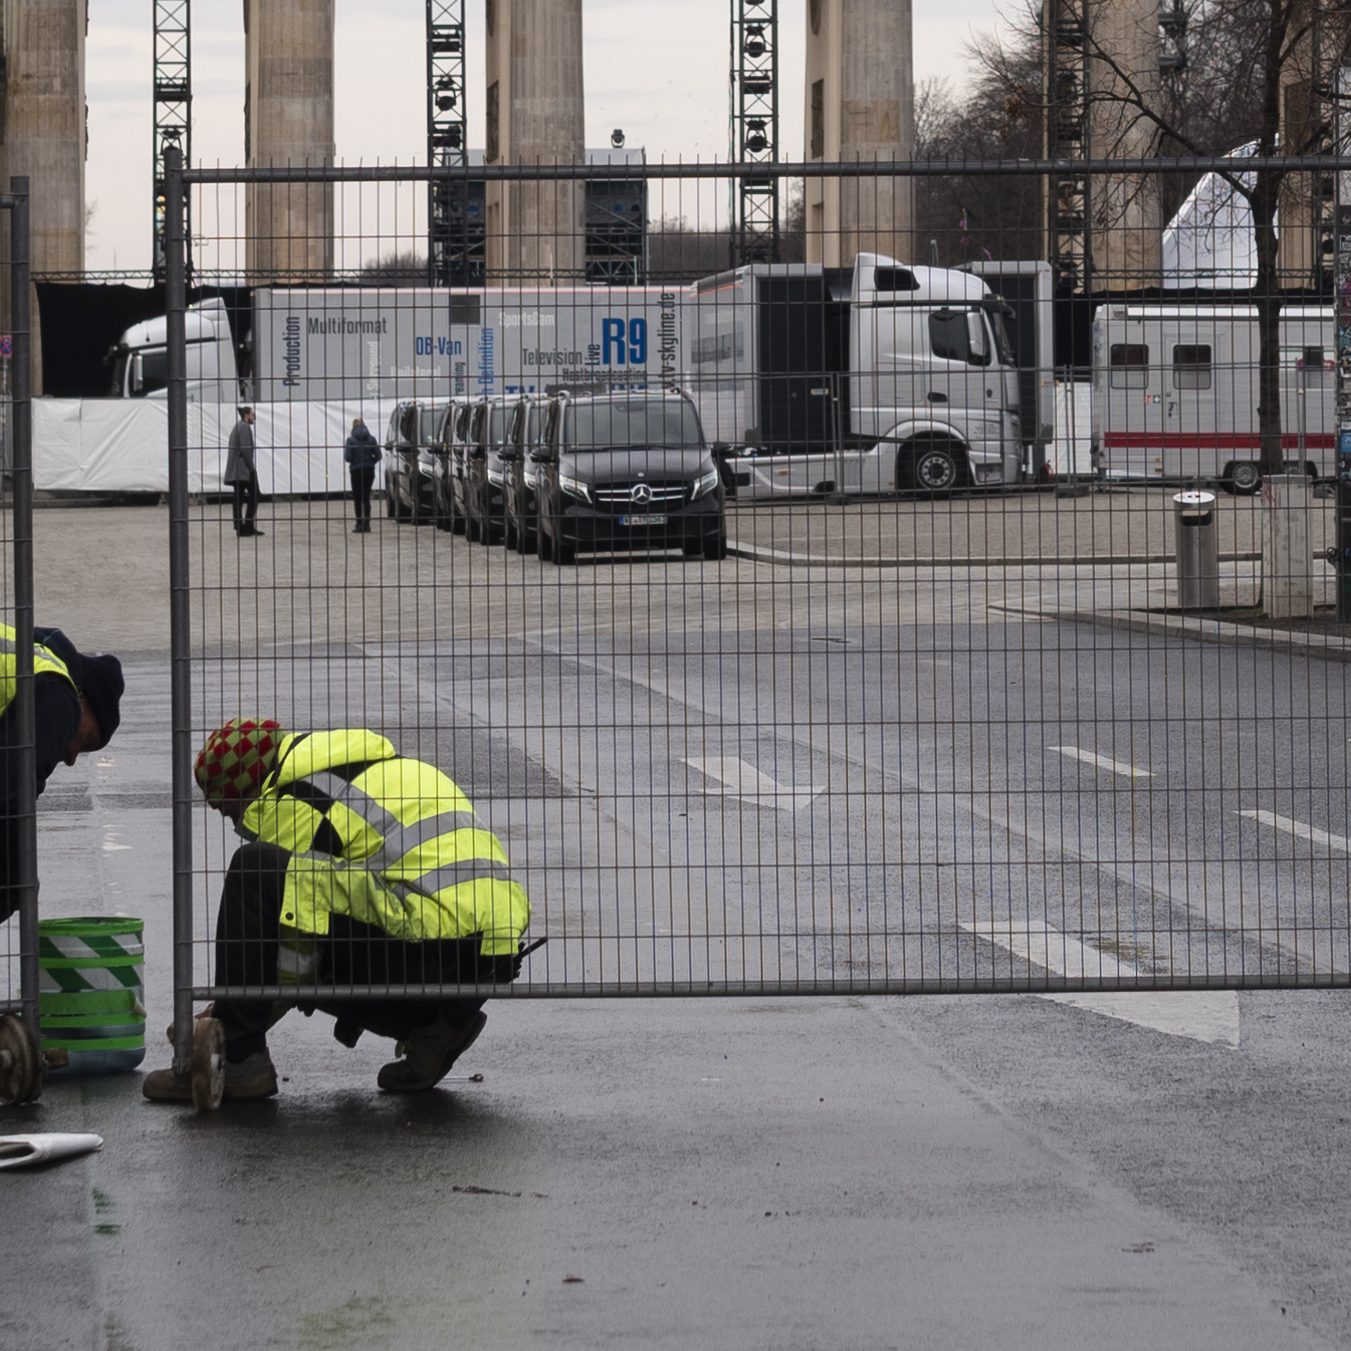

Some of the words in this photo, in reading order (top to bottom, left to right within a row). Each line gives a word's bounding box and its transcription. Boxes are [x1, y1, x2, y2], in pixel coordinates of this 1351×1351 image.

[308, 317, 388, 335] Multiformat
[499, 311, 555, 328] SportsCam
[282, 316, 300, 387] Production
[415, 336, 462, 356] OB-Van
[602, 317, 648, 365] R9
[366, 340, 379, 390] Surround
[477, 327, 494, 385] Definition
[522, 348, 583, 366] Television
[584, 344, 601, 366] Live
[562, 368, 648, 383] Hostbroadcasting
